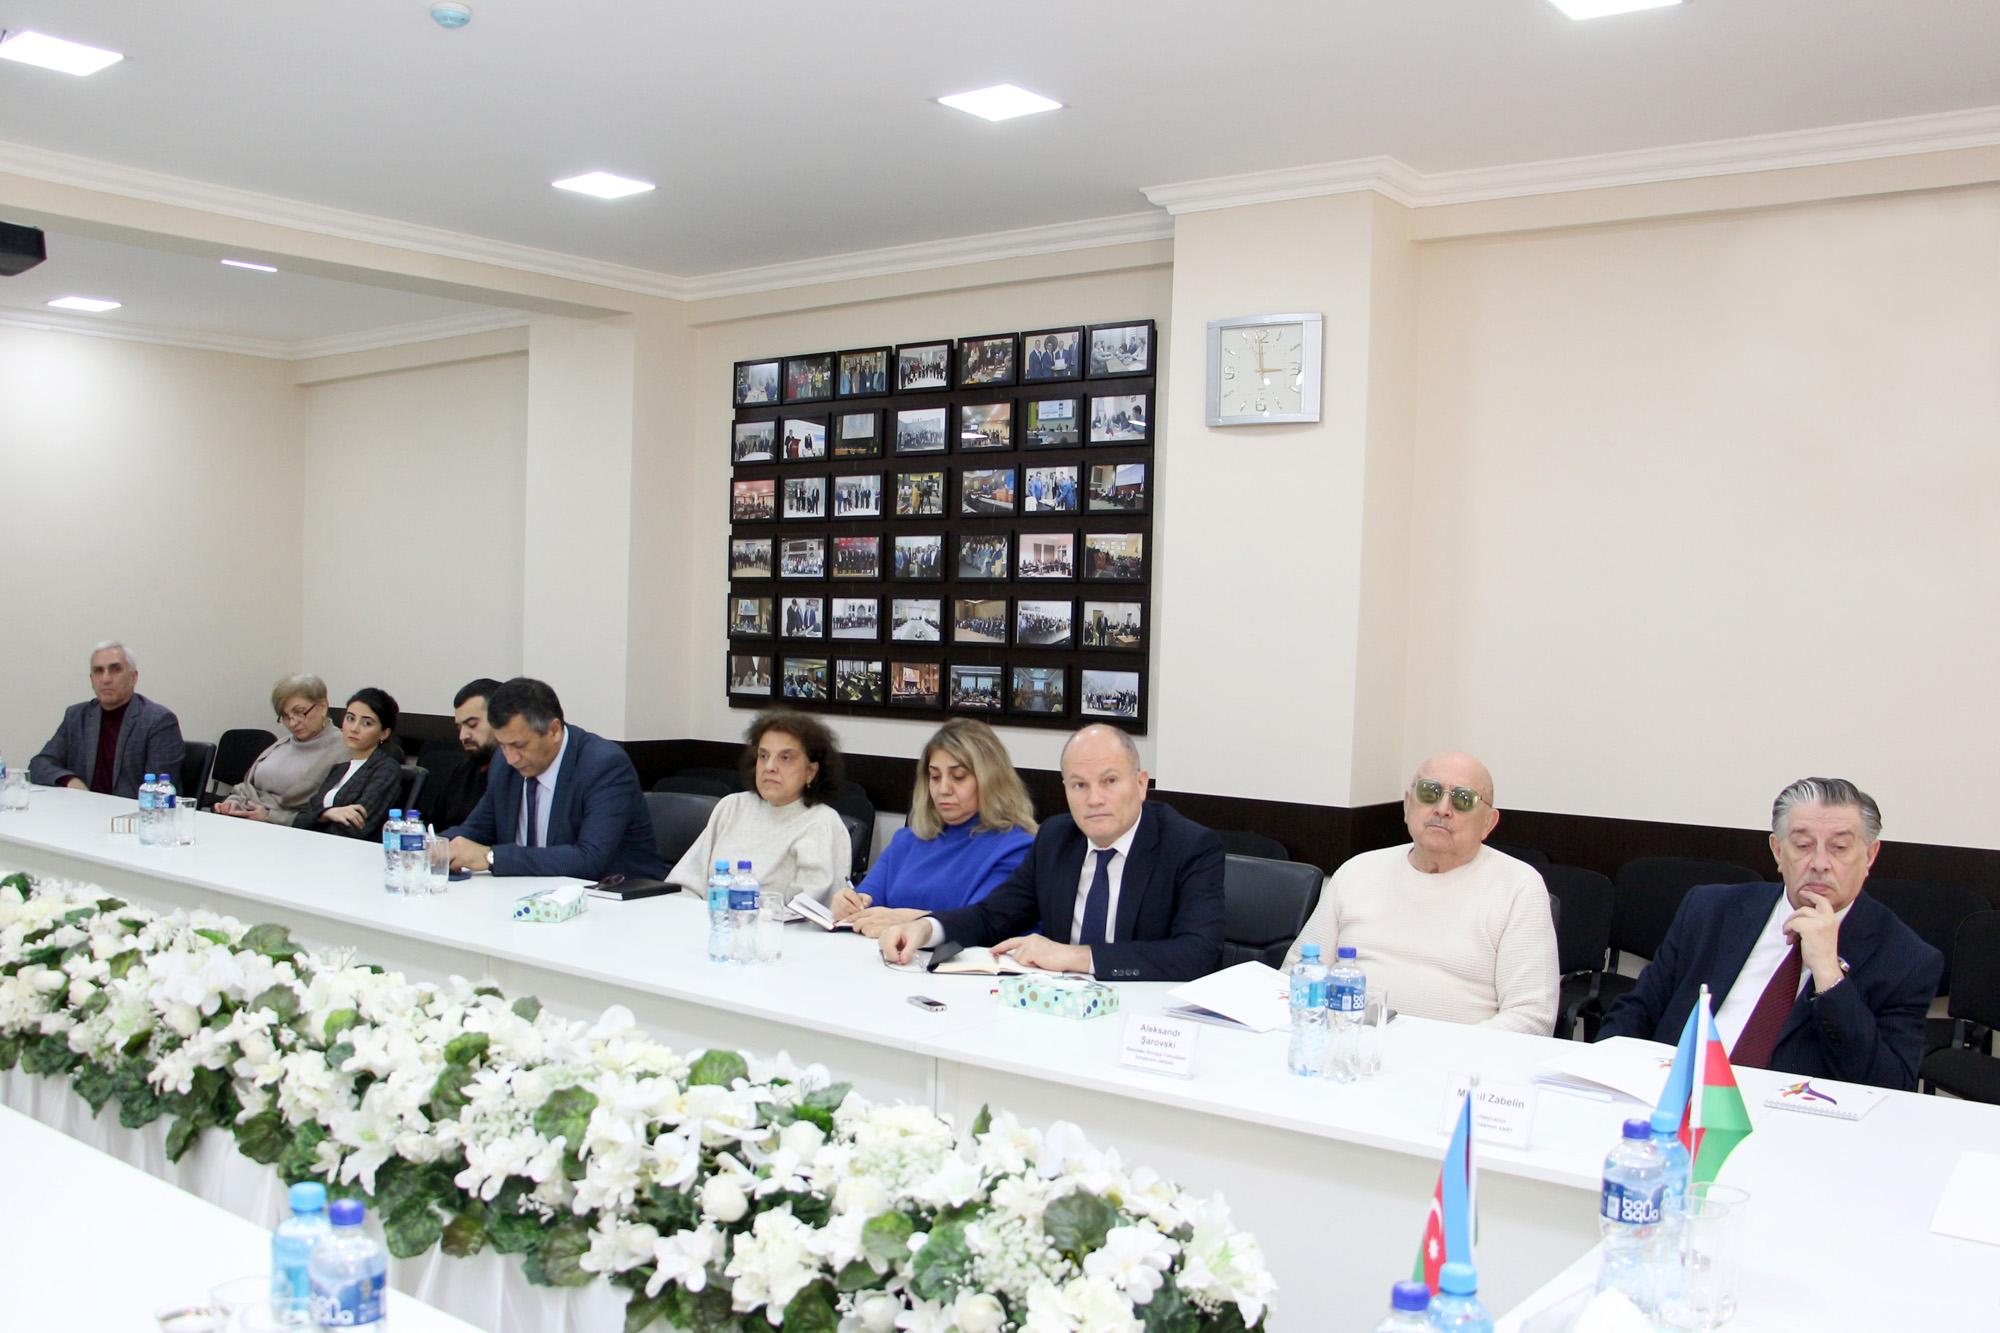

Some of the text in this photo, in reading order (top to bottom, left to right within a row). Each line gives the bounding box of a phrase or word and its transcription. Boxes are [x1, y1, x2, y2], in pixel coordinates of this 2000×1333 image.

[1224, 365, 1235, 380] 9
[1255, 397, 1267, 412] 6
[1140, 1023, 1181, 1037] Aleksandr
[1488, 1094, 1525, 1109] Zabelin
[1622, 1196, 1653, 1211] bon
[1622, 1207, 1659, 1223] aqua
